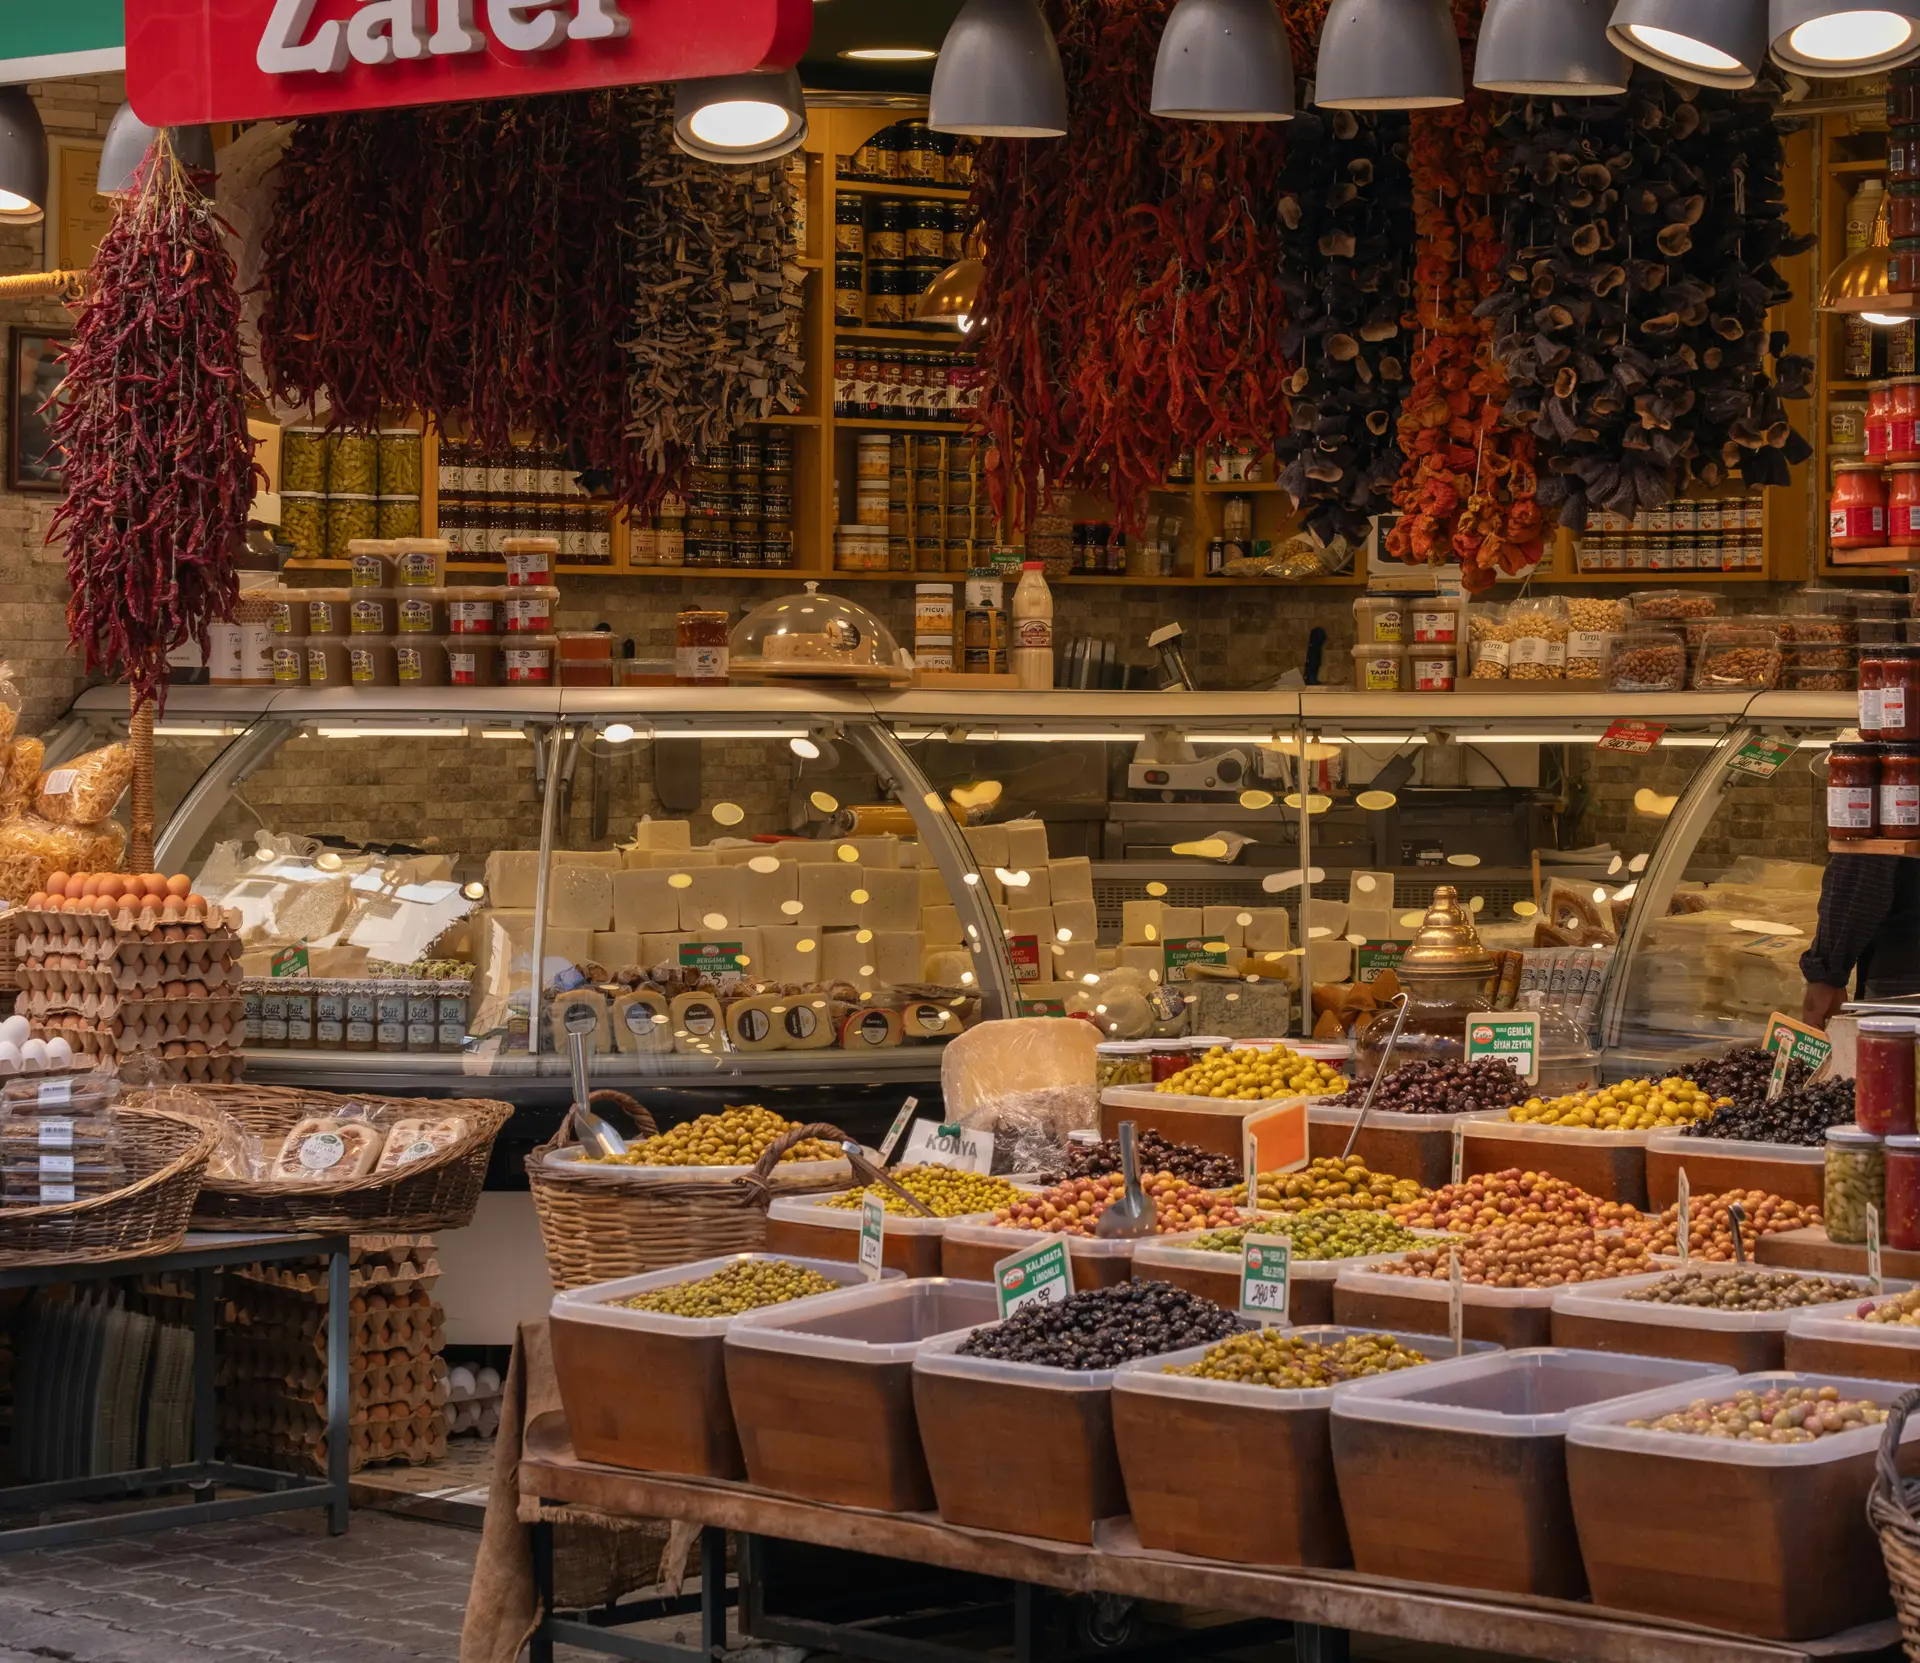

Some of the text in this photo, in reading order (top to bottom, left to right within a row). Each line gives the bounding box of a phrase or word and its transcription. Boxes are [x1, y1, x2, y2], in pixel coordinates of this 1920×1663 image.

[265, 1002, 280, 1014] Süt
[320, 1004, 336, 1016] Süt
[351, 1004, 368, 1016] Süt
[382, 1006, 398, 1018] Süt
[412, 1006, 428, 1018] Süt
[443, 1006, 459, 1018] Süt
[1507, 1024, 1532, 1037] GEMLİK
[1493, 1038, 1532, 1050] SİYAH ZEYTİN
[1797, 1042, 1828, 1060] GEMLİ
[925, 1134, 978, 1158] KONYA
[1025, 1248, 1062, 1274] KALAMATA
[1032, 1263, 1060, 1286] LİMONLU
